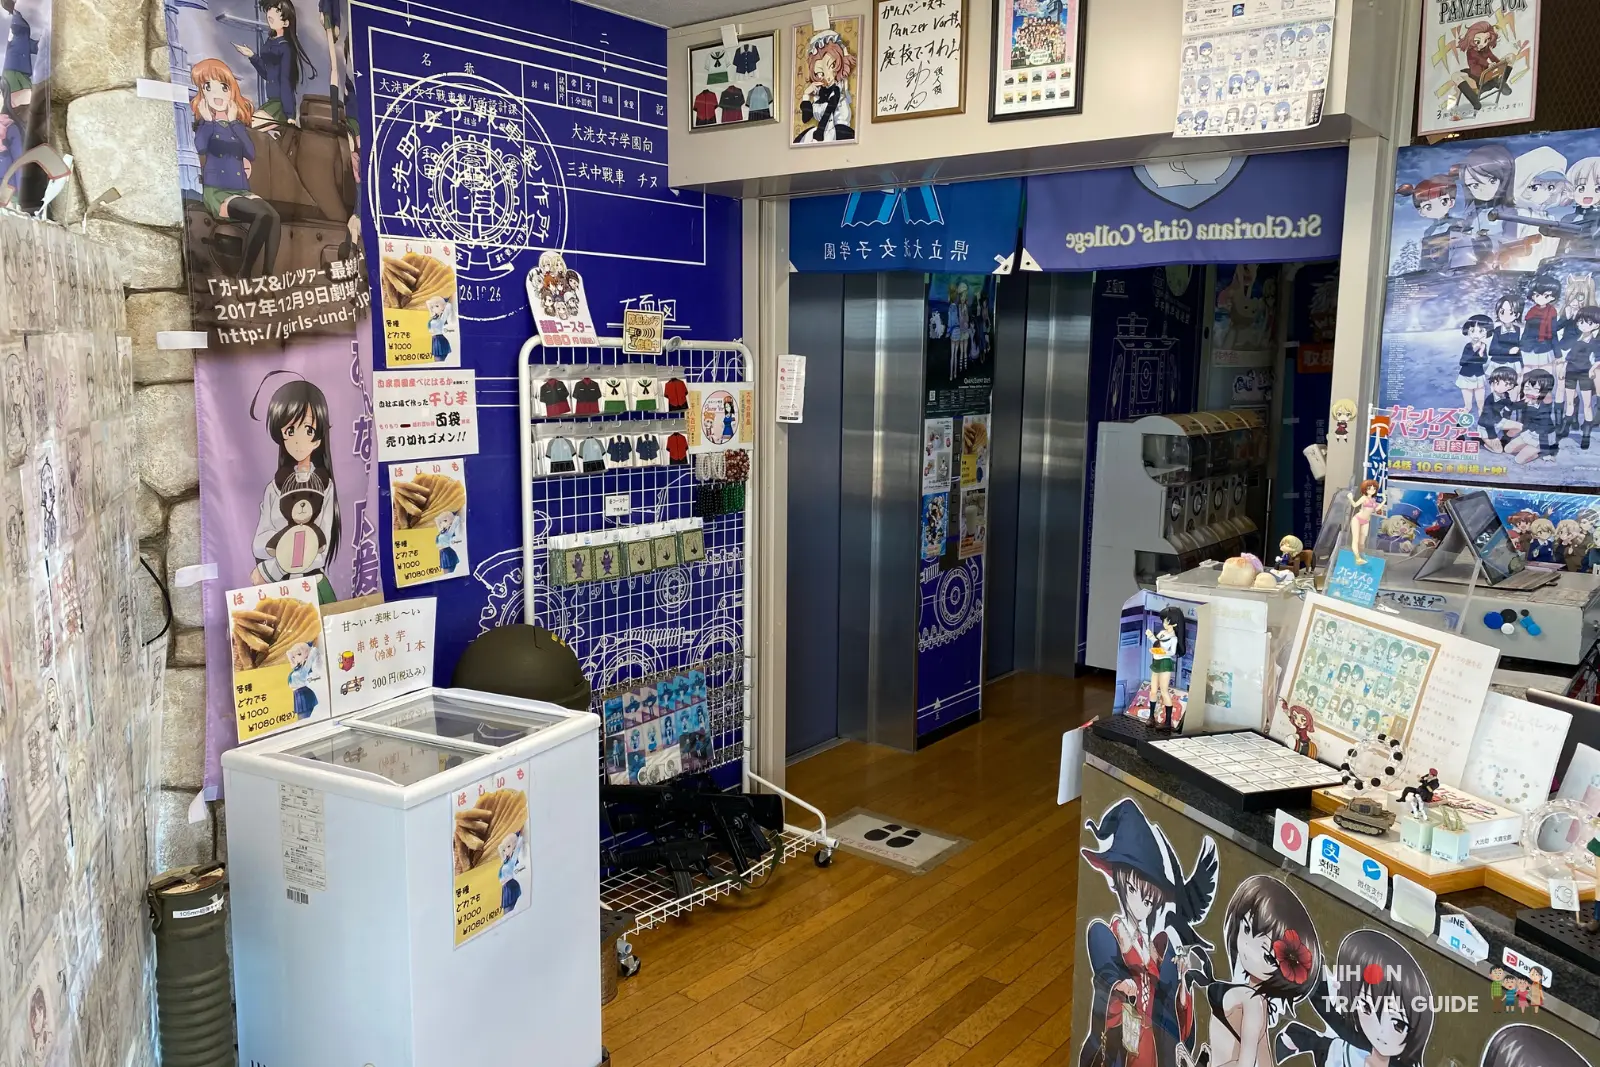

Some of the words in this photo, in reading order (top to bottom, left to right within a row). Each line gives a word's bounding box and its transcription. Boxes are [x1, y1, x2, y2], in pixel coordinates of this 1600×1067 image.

[384, 241, 451, 256] ほしいも
[393, 460, 460, 478] ほしいも
[232, 580, 312, 606] ほしいも
[457, 767, 525, 807] ほしいも
[1449, 916, 1465, 930] INE
